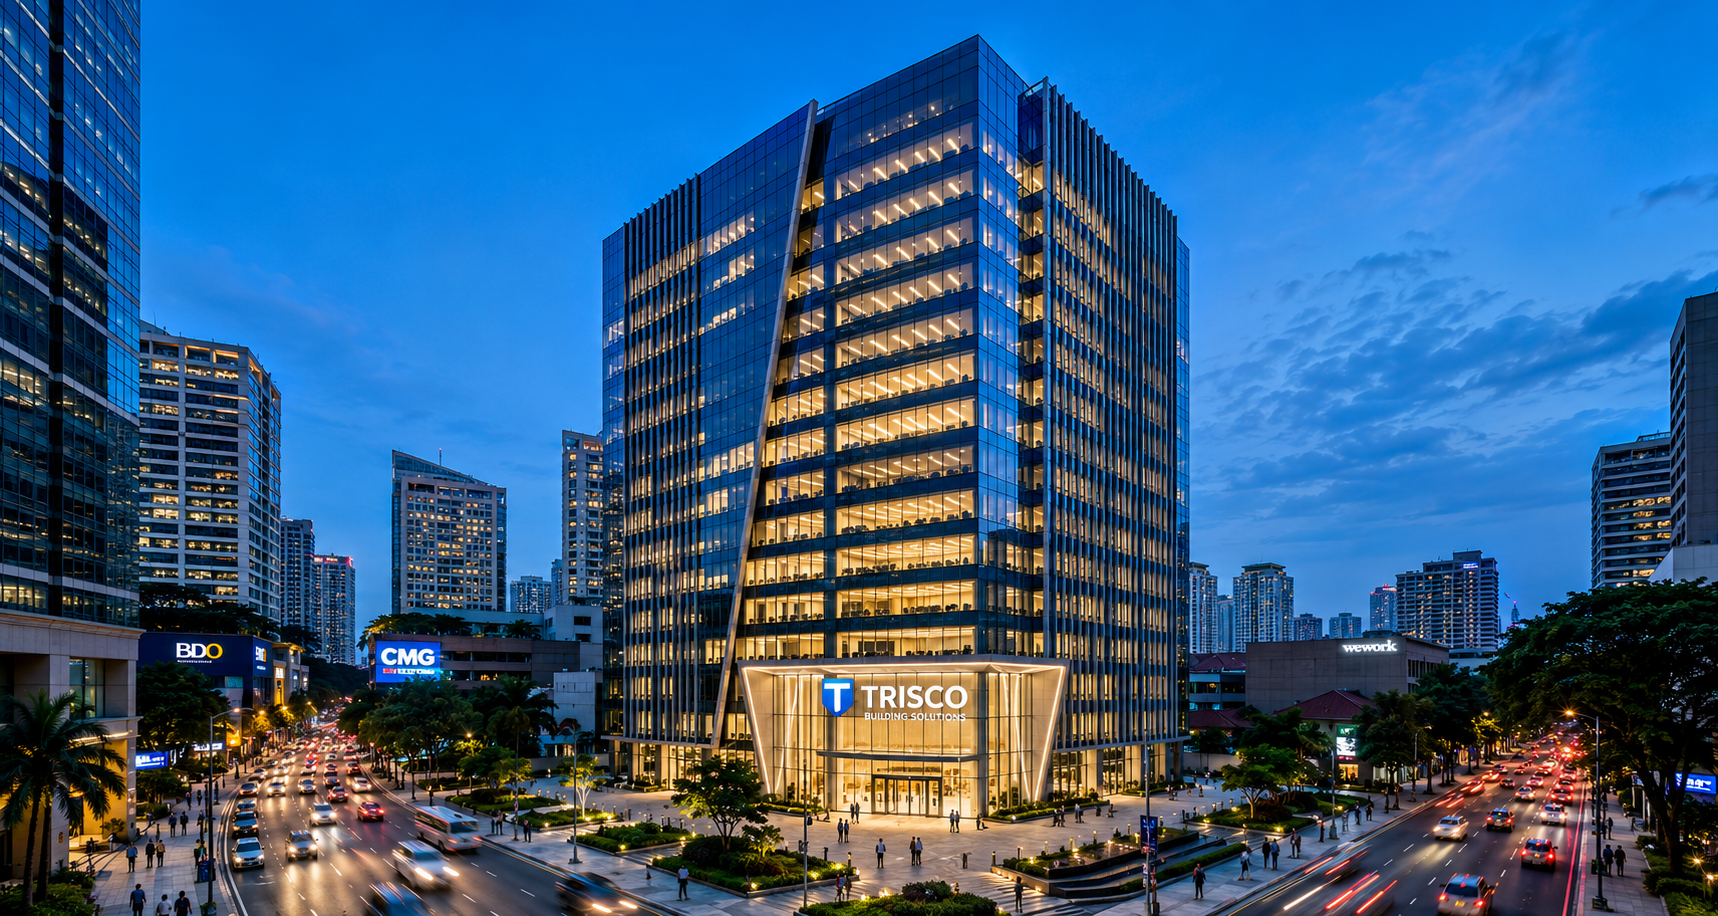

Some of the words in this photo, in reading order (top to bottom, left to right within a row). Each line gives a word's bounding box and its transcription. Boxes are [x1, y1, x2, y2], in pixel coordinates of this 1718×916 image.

[176, 643, 223, 659] BDO
[1342, 640, 1397, 652] wework
[381, 648, 435, 666] CMG
[861, 685, 968, 709] TRISCO
[864, 712, 908, 721] BUILDING
[911, 712, 966, 722] SOLUTIONS
